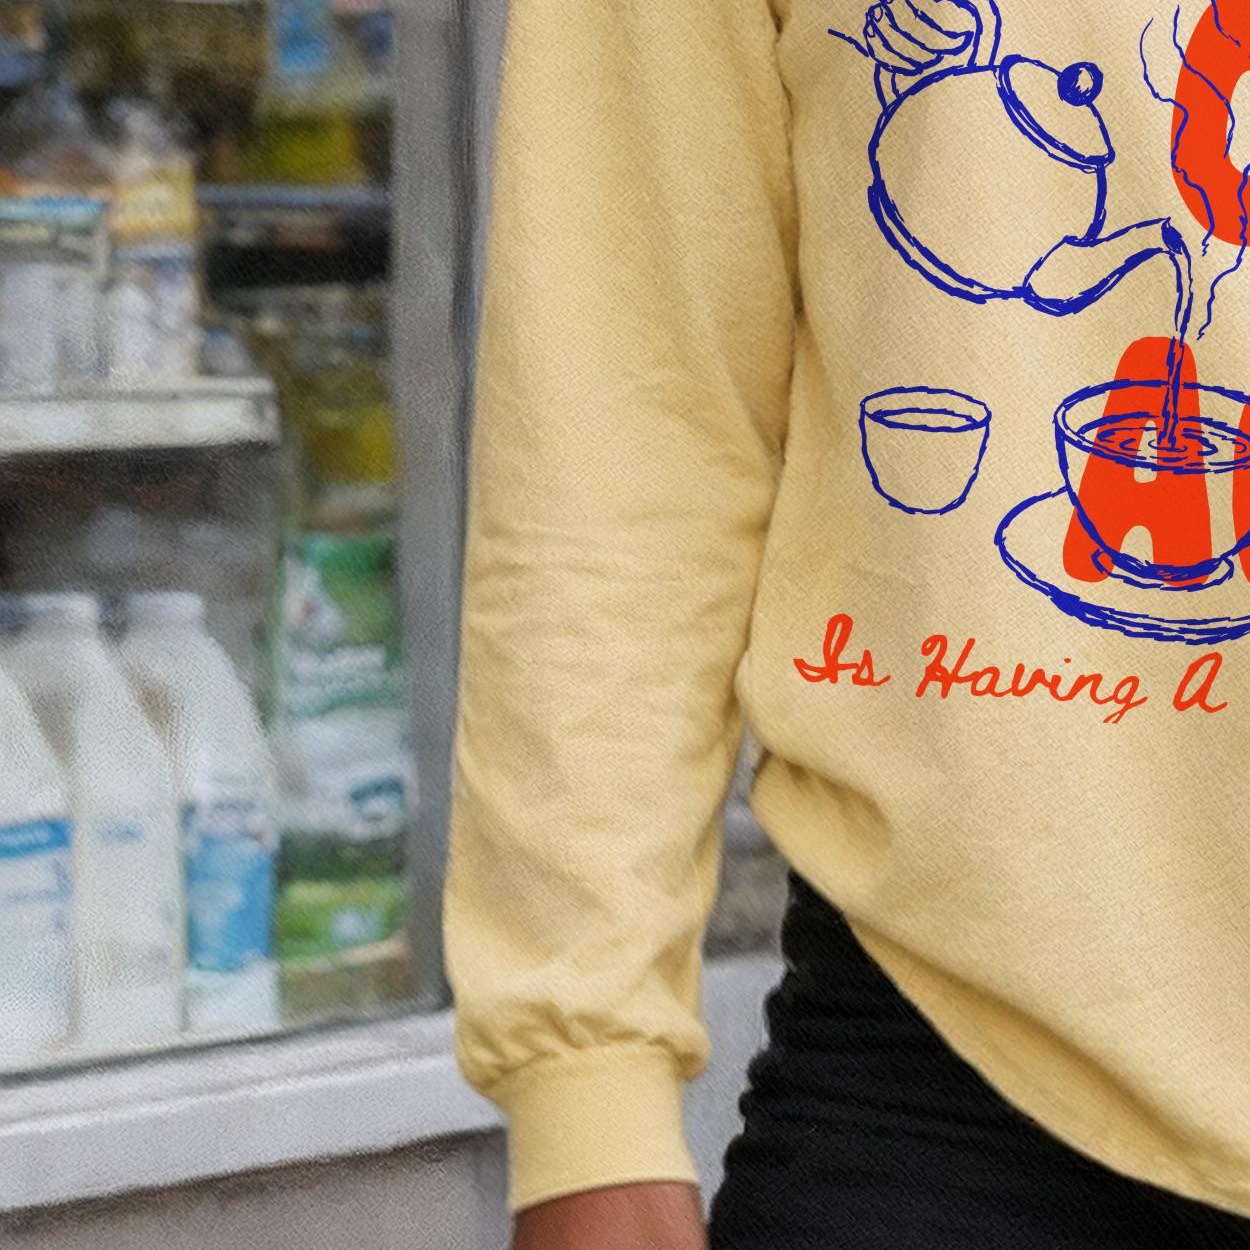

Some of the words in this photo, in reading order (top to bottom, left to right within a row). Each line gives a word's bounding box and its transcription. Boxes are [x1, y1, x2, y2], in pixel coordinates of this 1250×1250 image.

[792, 613, 892, 687] Is
[915, 634, 1148, 724] Having
[1172, 651, 1228, 714] A
